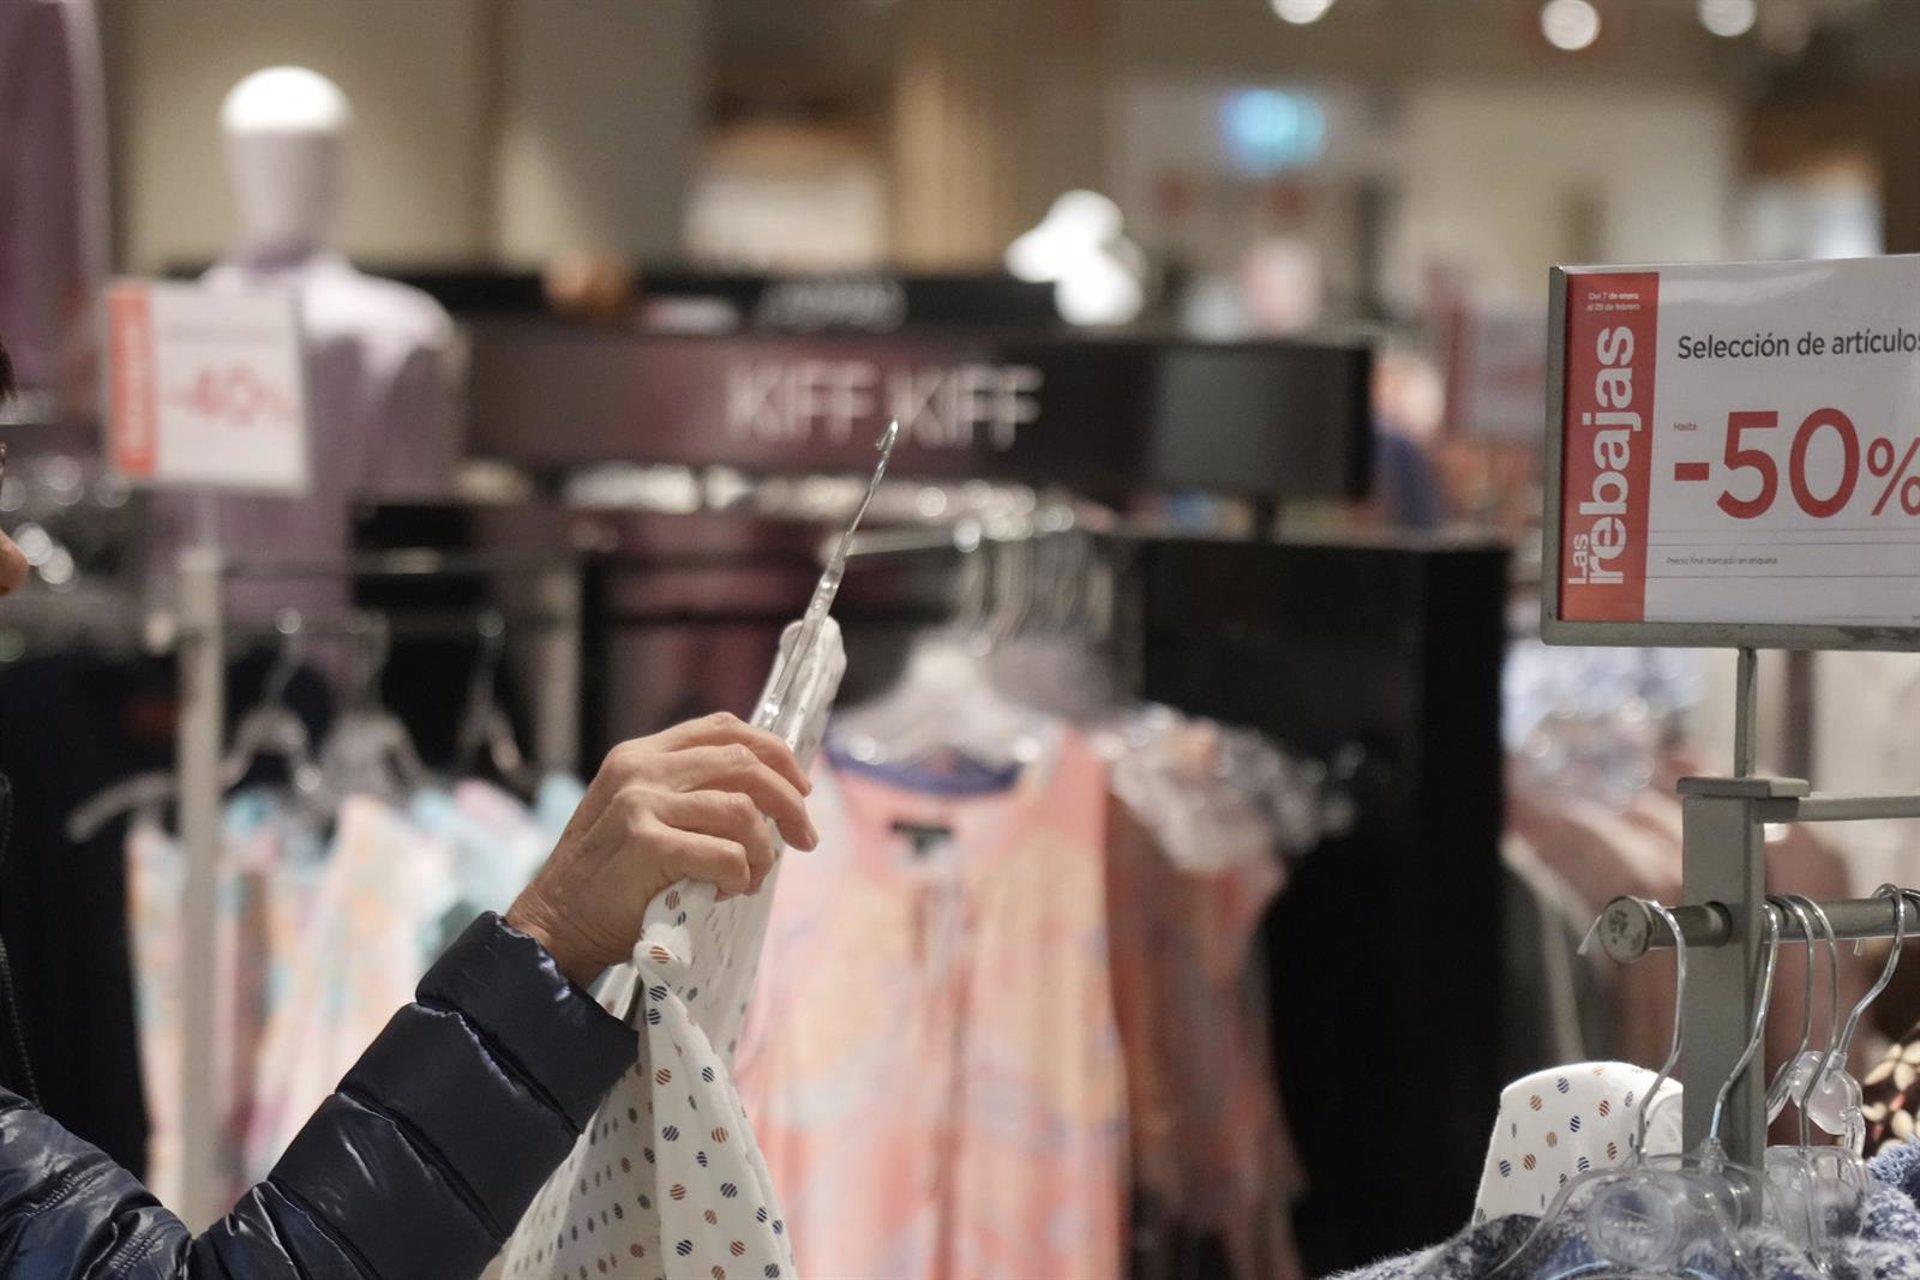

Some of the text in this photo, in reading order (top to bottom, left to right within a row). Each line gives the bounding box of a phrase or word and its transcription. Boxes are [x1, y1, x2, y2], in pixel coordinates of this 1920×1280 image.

[1605, 303, 1614, 311] de
[1615, 302, 1641, 311] febrero
[1608, 292, 1618, 300] de
[1619, 292, 1640, 300] enero
[1677, 327, 1920, 360] Selección de artículo
[1673, 421, 1697, 432] Hasta
[1579, 325, 1642, 584] rebajas
[1674, 407, 1920, 519] -50%
[1567, 533, 1590, 584] Las
[1666, 556, 1689, 565] Precio
[1690, 556, 1704, 565] final
[1705, 557, 1736, 565] marcado
